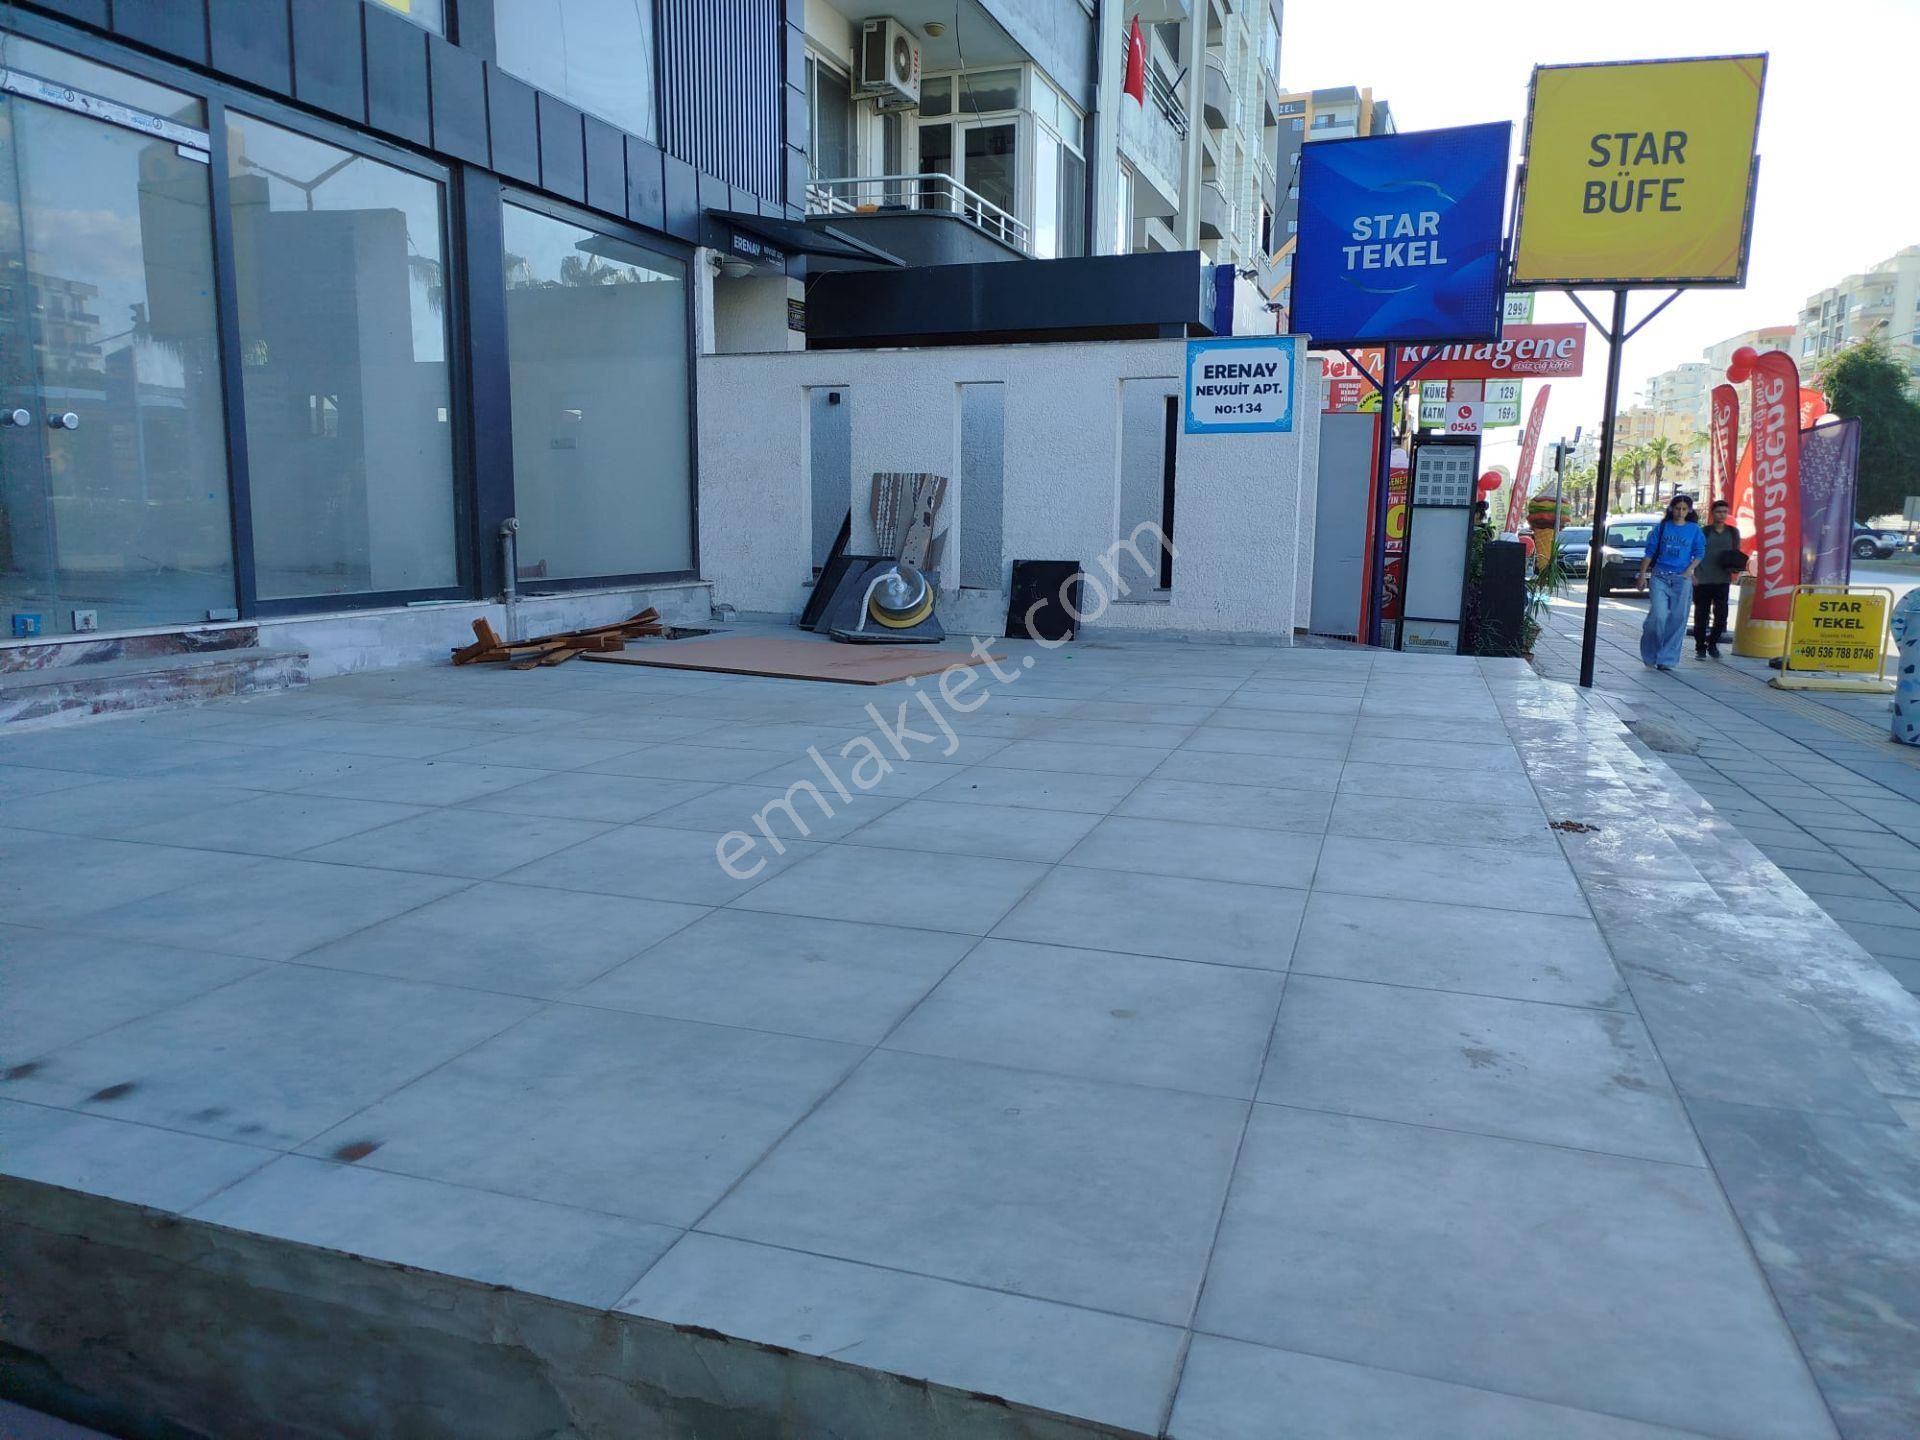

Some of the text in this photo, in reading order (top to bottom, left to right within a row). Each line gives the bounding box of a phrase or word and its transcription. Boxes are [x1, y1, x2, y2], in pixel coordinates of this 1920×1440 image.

[1588, 130, 1688, 167] STAR
[1583, 171, 1684, 214] BÜFE
[1352, 210, 1441, 241] STAR
[733, 235, 760, 256] ERENAY
[1342, 240, 1448, 270] TEKEL
[1204, 363, 1278, 380] ERENAY
[1196, 382, 1283, 396] NEVSUİT APT.
[1424, 384, 1455, 399] KÜNEE
[1214, 403, 1262, 414] NO:134
[1450, 423, 1477, 432] 0545
[1819, 601, 1861, 613] STAR
[1812, 617, 1864, 629] TEKEL
[1800, 646, 1874, 660] +90 536 788 8746
